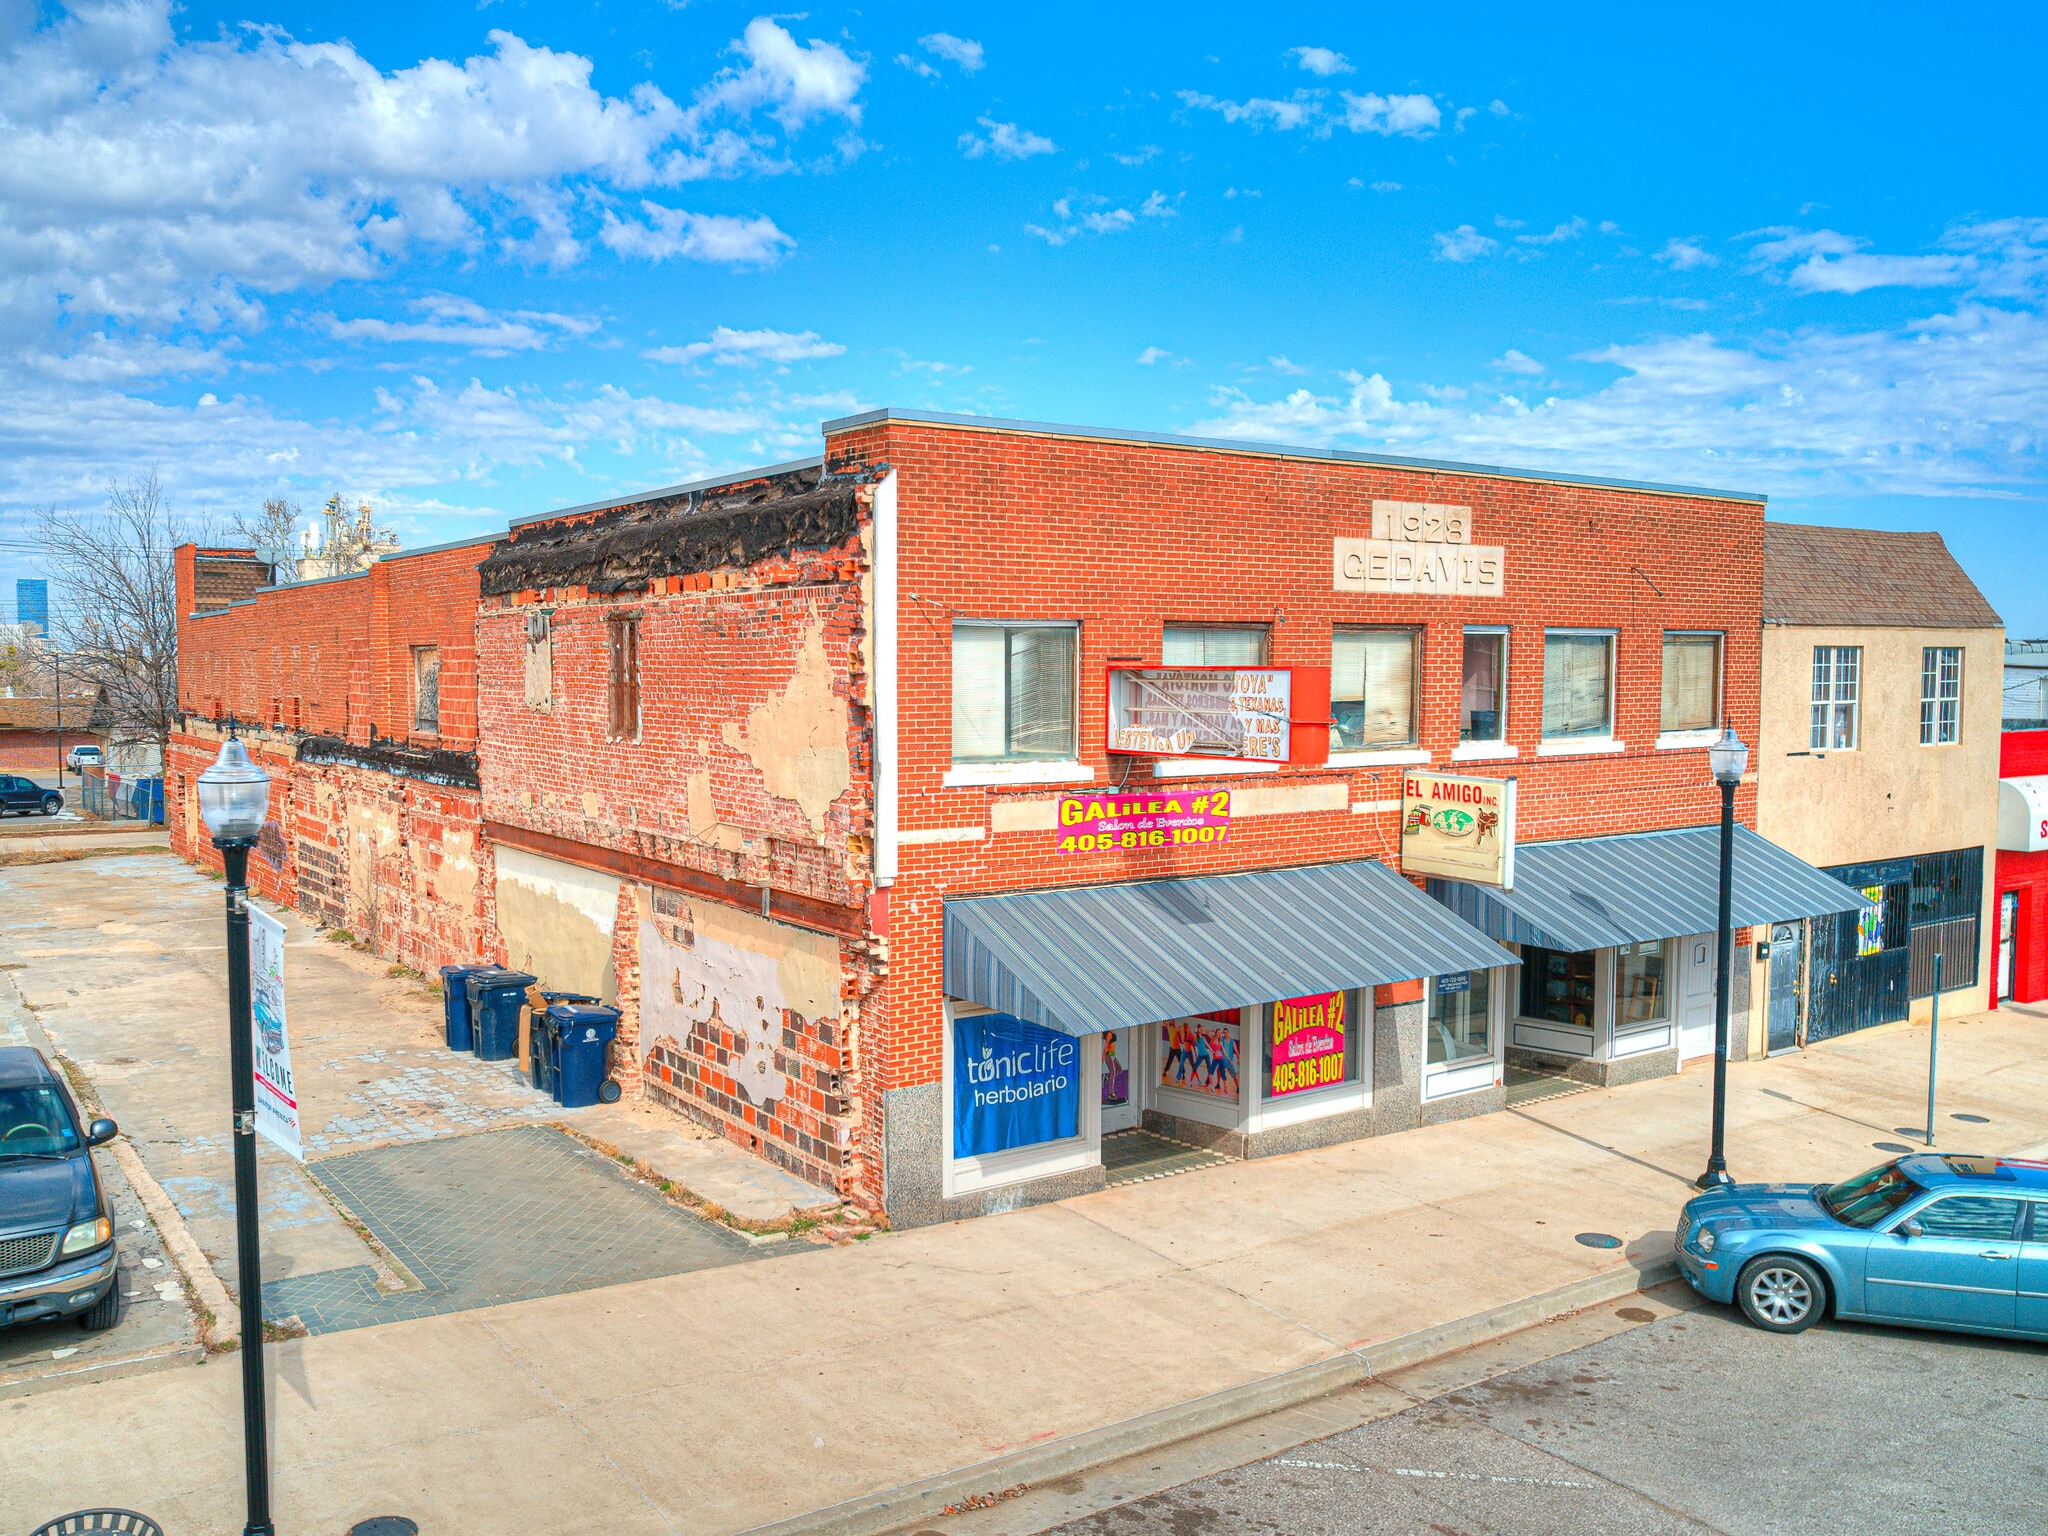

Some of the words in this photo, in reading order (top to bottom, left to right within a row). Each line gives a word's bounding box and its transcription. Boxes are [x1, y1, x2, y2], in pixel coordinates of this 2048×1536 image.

[1384, 512, 1463, 545] 1928
[1191, 790, 1230, 818] #2
[1406, 779, 1423, 798] EL
[1431, 781, 1482, 805] AMIGO
[1059, 825, 1229, 853] 405-816-1007
[1097, 818, 1135, 832] Salon
[1137, 817, 1154, 830] de
[1156, 816, 1205, 828] Eventos
[1327, 990, 1344, 1035] #2
[255, 1046, 294, 1095] WELCOME
[1273, 1051, 1344, 1093] 405-816-1007
[973, 1074, 1068, 1107] herbolario
